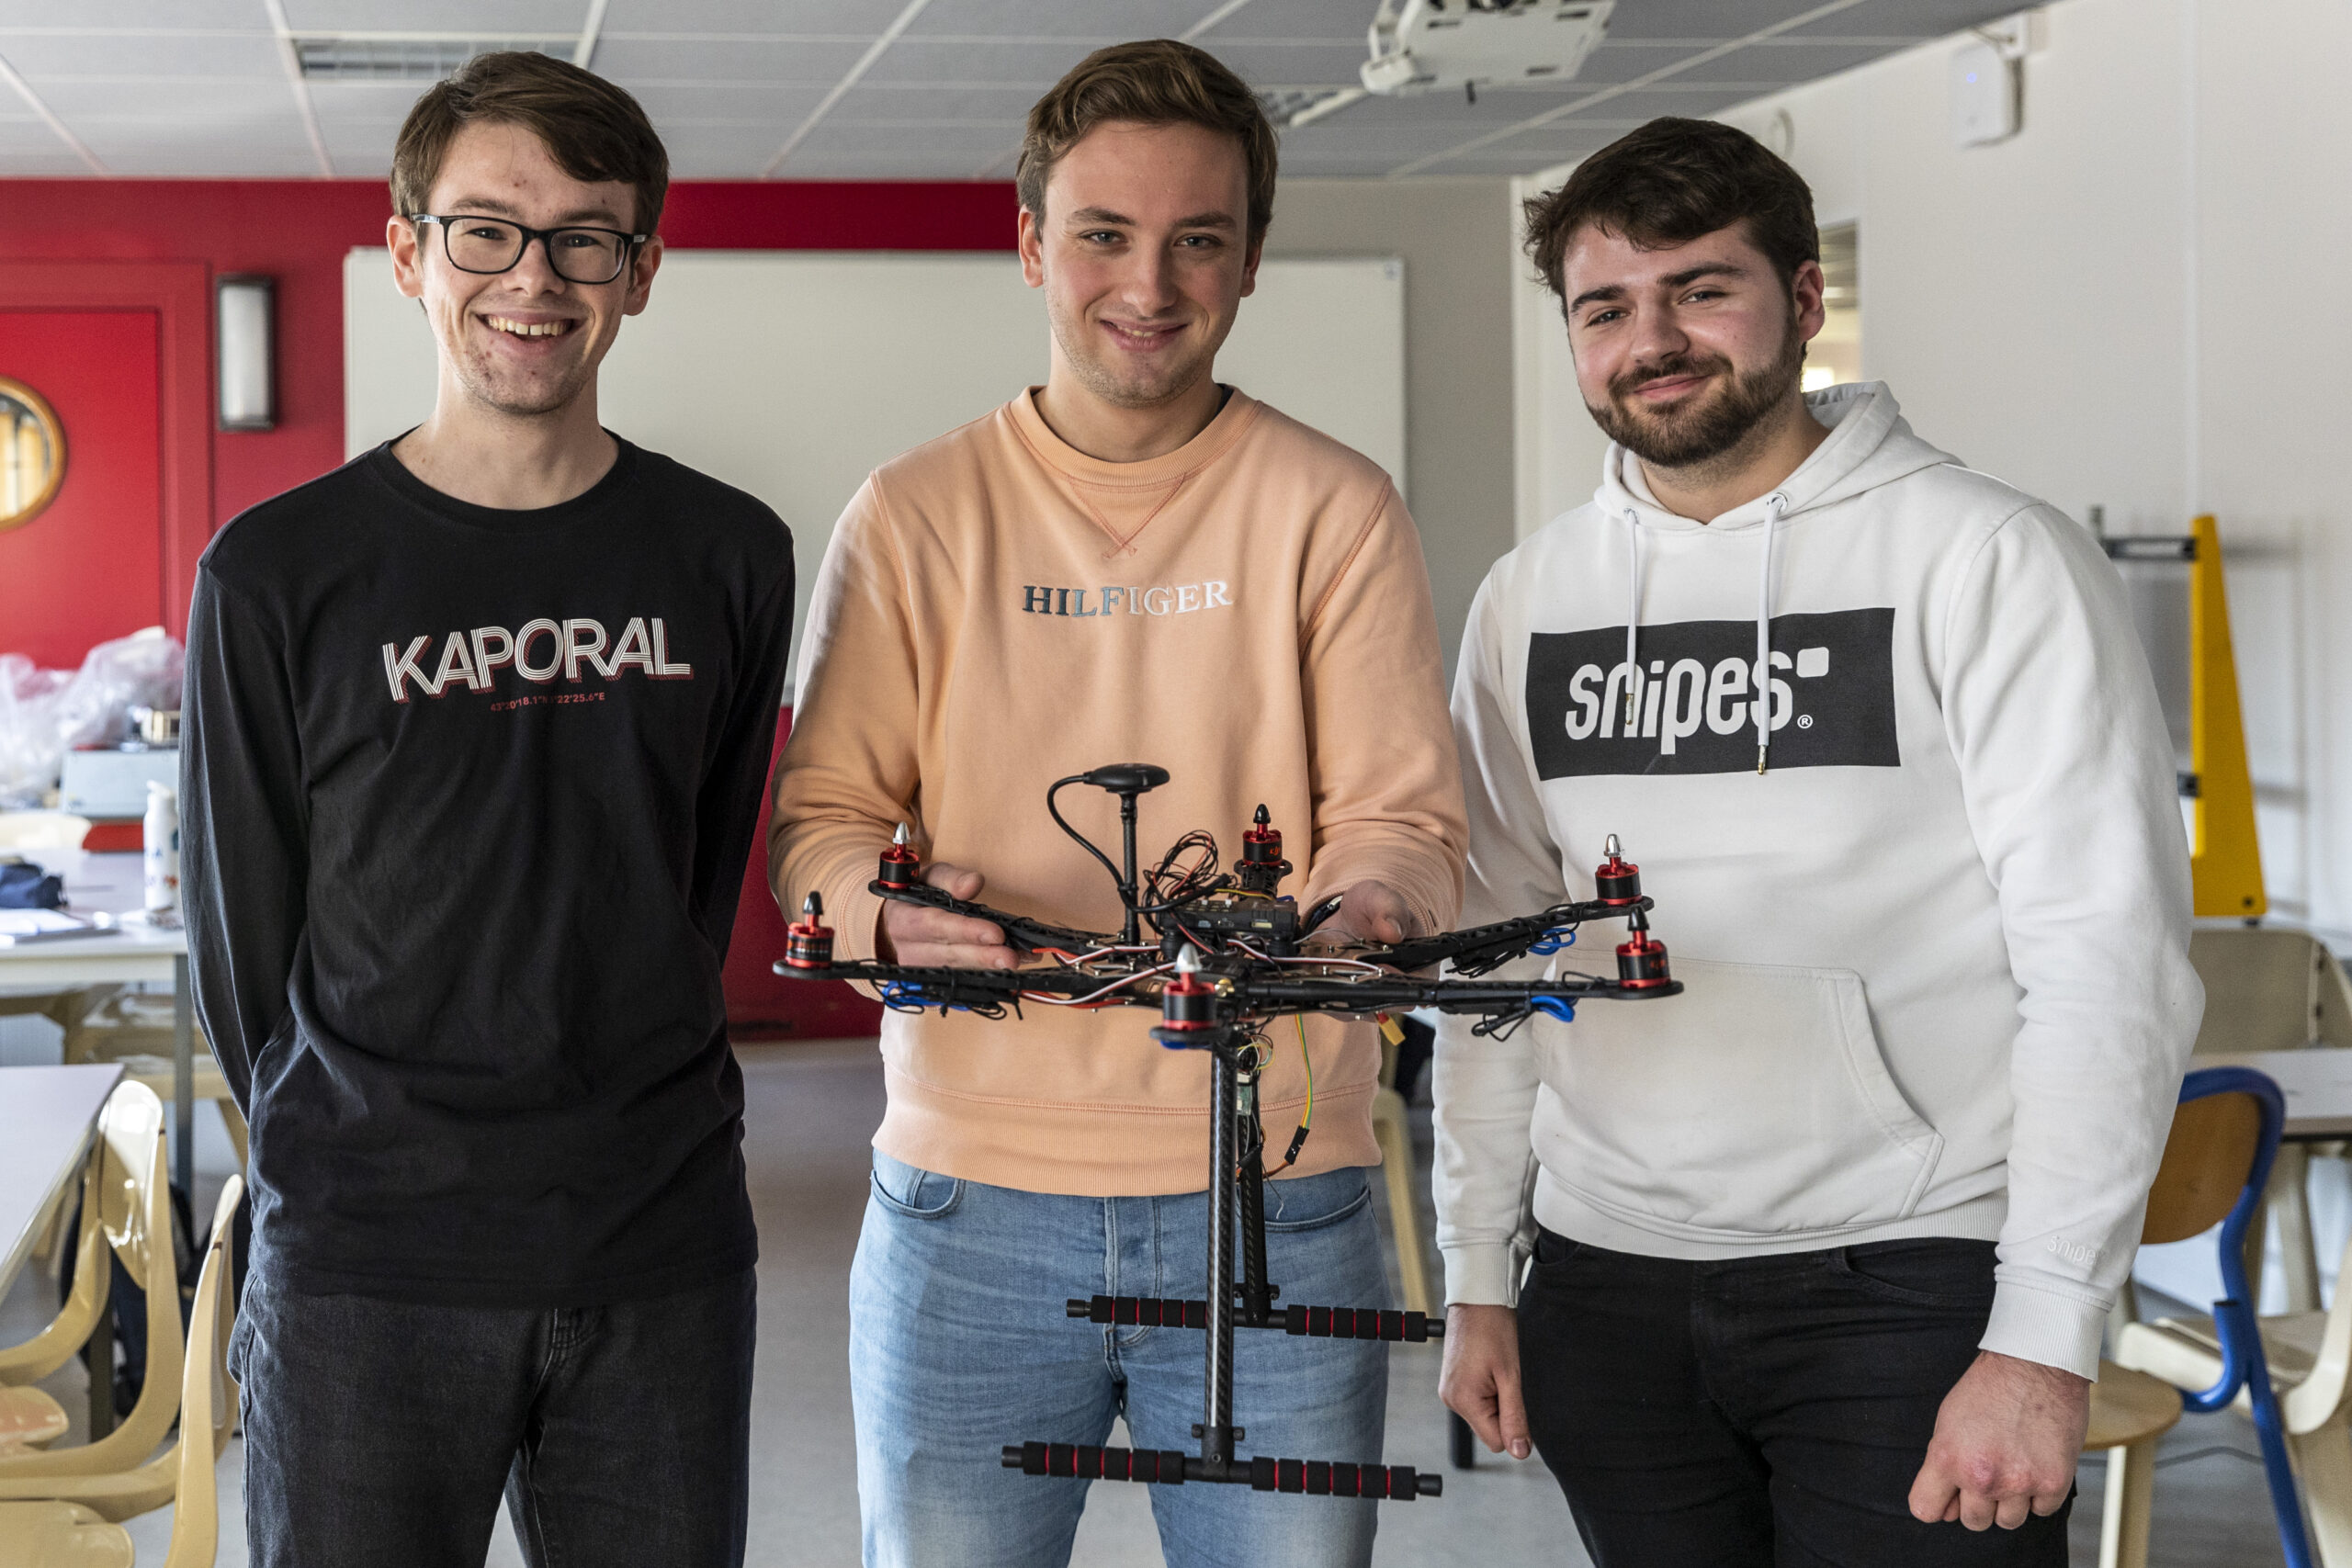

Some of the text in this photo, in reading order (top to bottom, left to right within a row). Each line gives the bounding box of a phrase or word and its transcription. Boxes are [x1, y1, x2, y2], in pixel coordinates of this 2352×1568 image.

[1021, 580, 1233, 618] HILFIGER
[382, 616, 694, 704] KAPORAL
[1565, 649, 1793, 755] snipes
